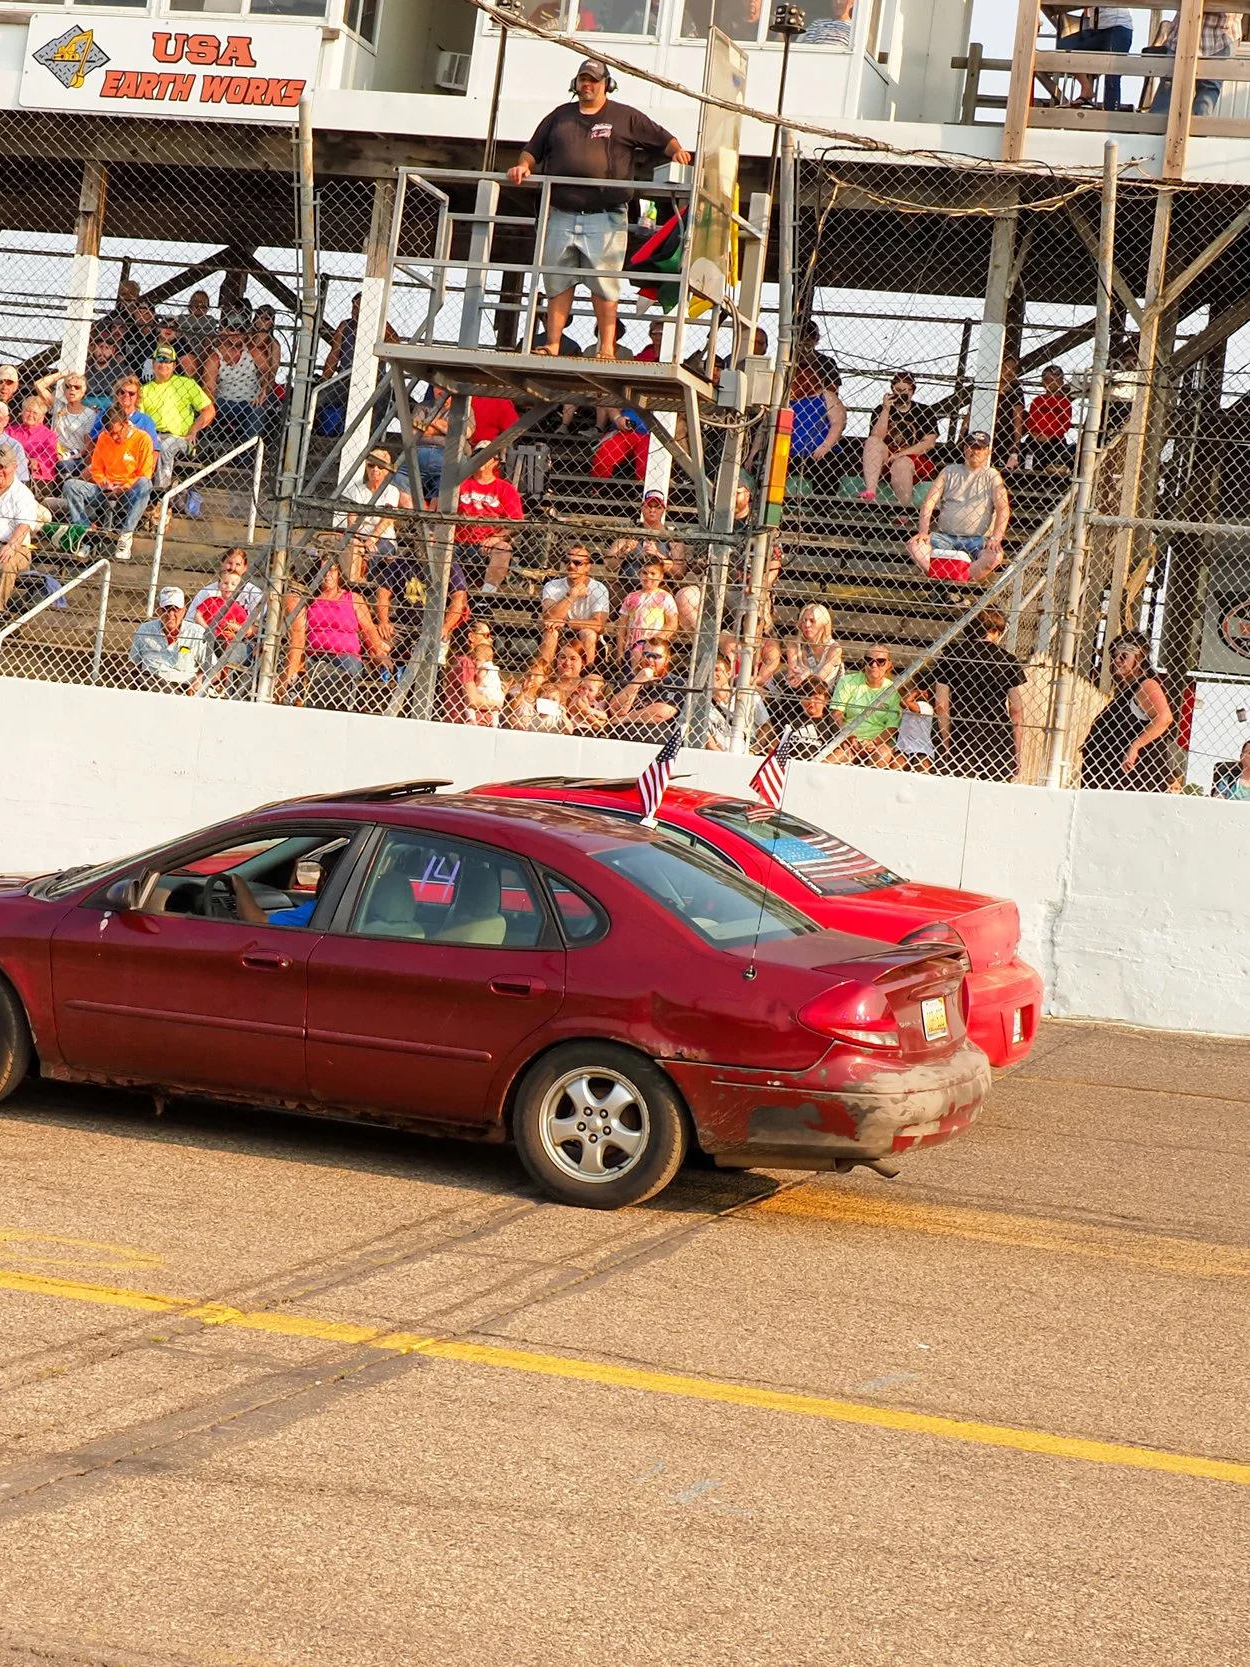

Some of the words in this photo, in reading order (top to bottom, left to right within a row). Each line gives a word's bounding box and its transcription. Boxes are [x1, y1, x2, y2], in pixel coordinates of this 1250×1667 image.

[152, 31, 256, 67] USA
[100, 70, 196, 101] EARTH
[200, 75, 306, 107] WORKS
[419, 855, 461, 903] 14
